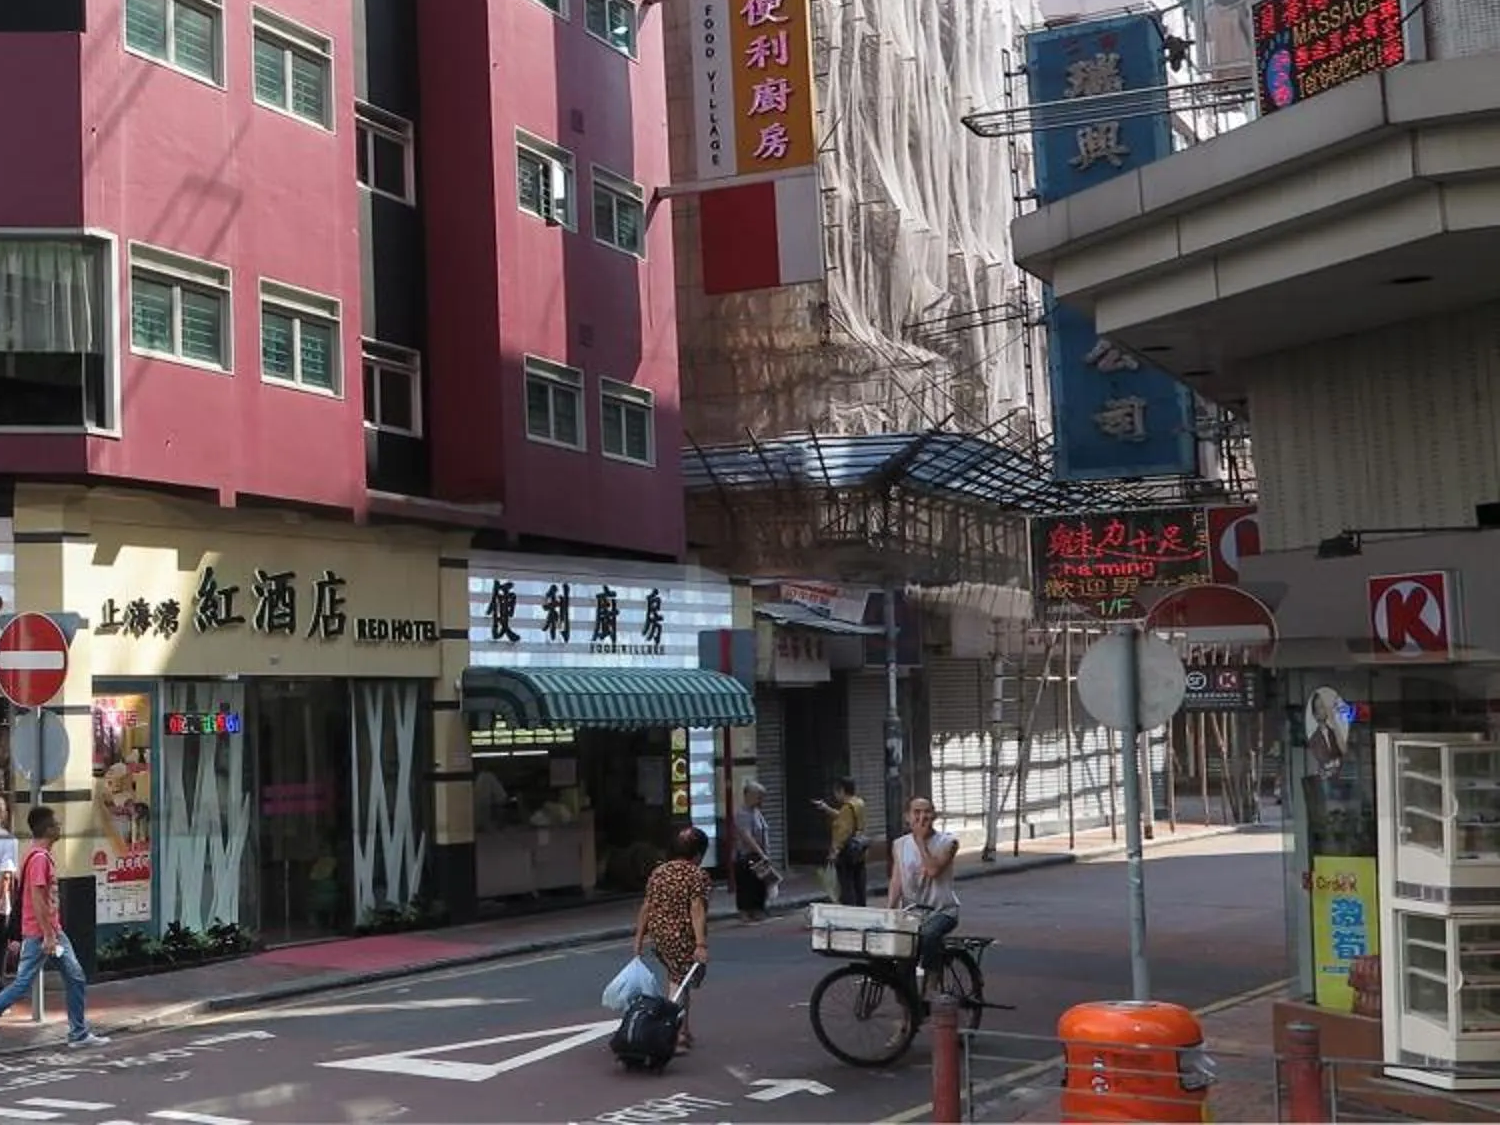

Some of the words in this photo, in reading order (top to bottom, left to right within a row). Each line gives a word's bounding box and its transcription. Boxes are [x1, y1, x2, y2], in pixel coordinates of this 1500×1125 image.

[704, 4, 715, 59] FOOD
[706, 71, 722, 167] VILLAGE
[1046, 518, 1189, 559] 魅力十足
[193, 566, 347, 641] 紅酒店
[354, 617, 390, 643] RED
[391, 618, 439, 643] HOTEL
[1097, 597, 1133, 616] 1/F
[1385, 586, 1437, 652] K
